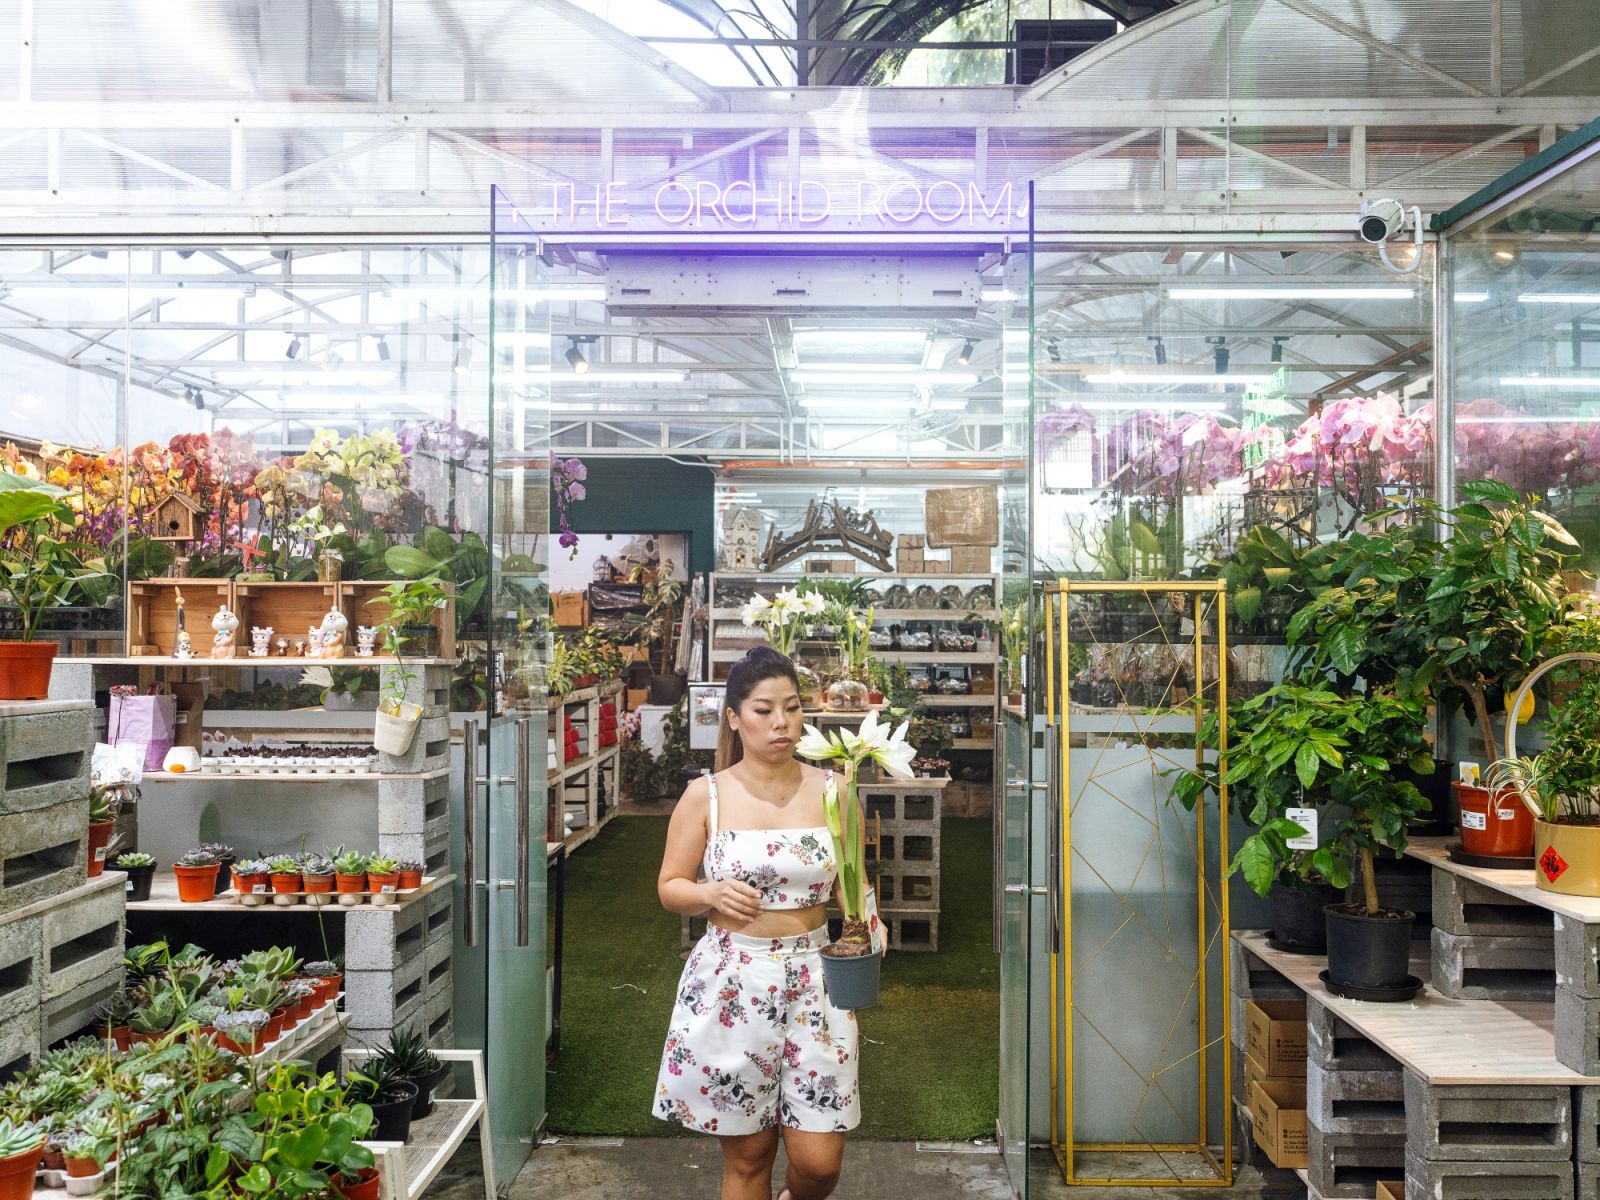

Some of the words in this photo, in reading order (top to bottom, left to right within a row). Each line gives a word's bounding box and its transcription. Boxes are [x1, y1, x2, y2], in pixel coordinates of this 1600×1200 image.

[543, 181, 628, 225] THE
[656, 181, 831, 225] ORCHID
[858, 180, 1012, 225] ROOM
